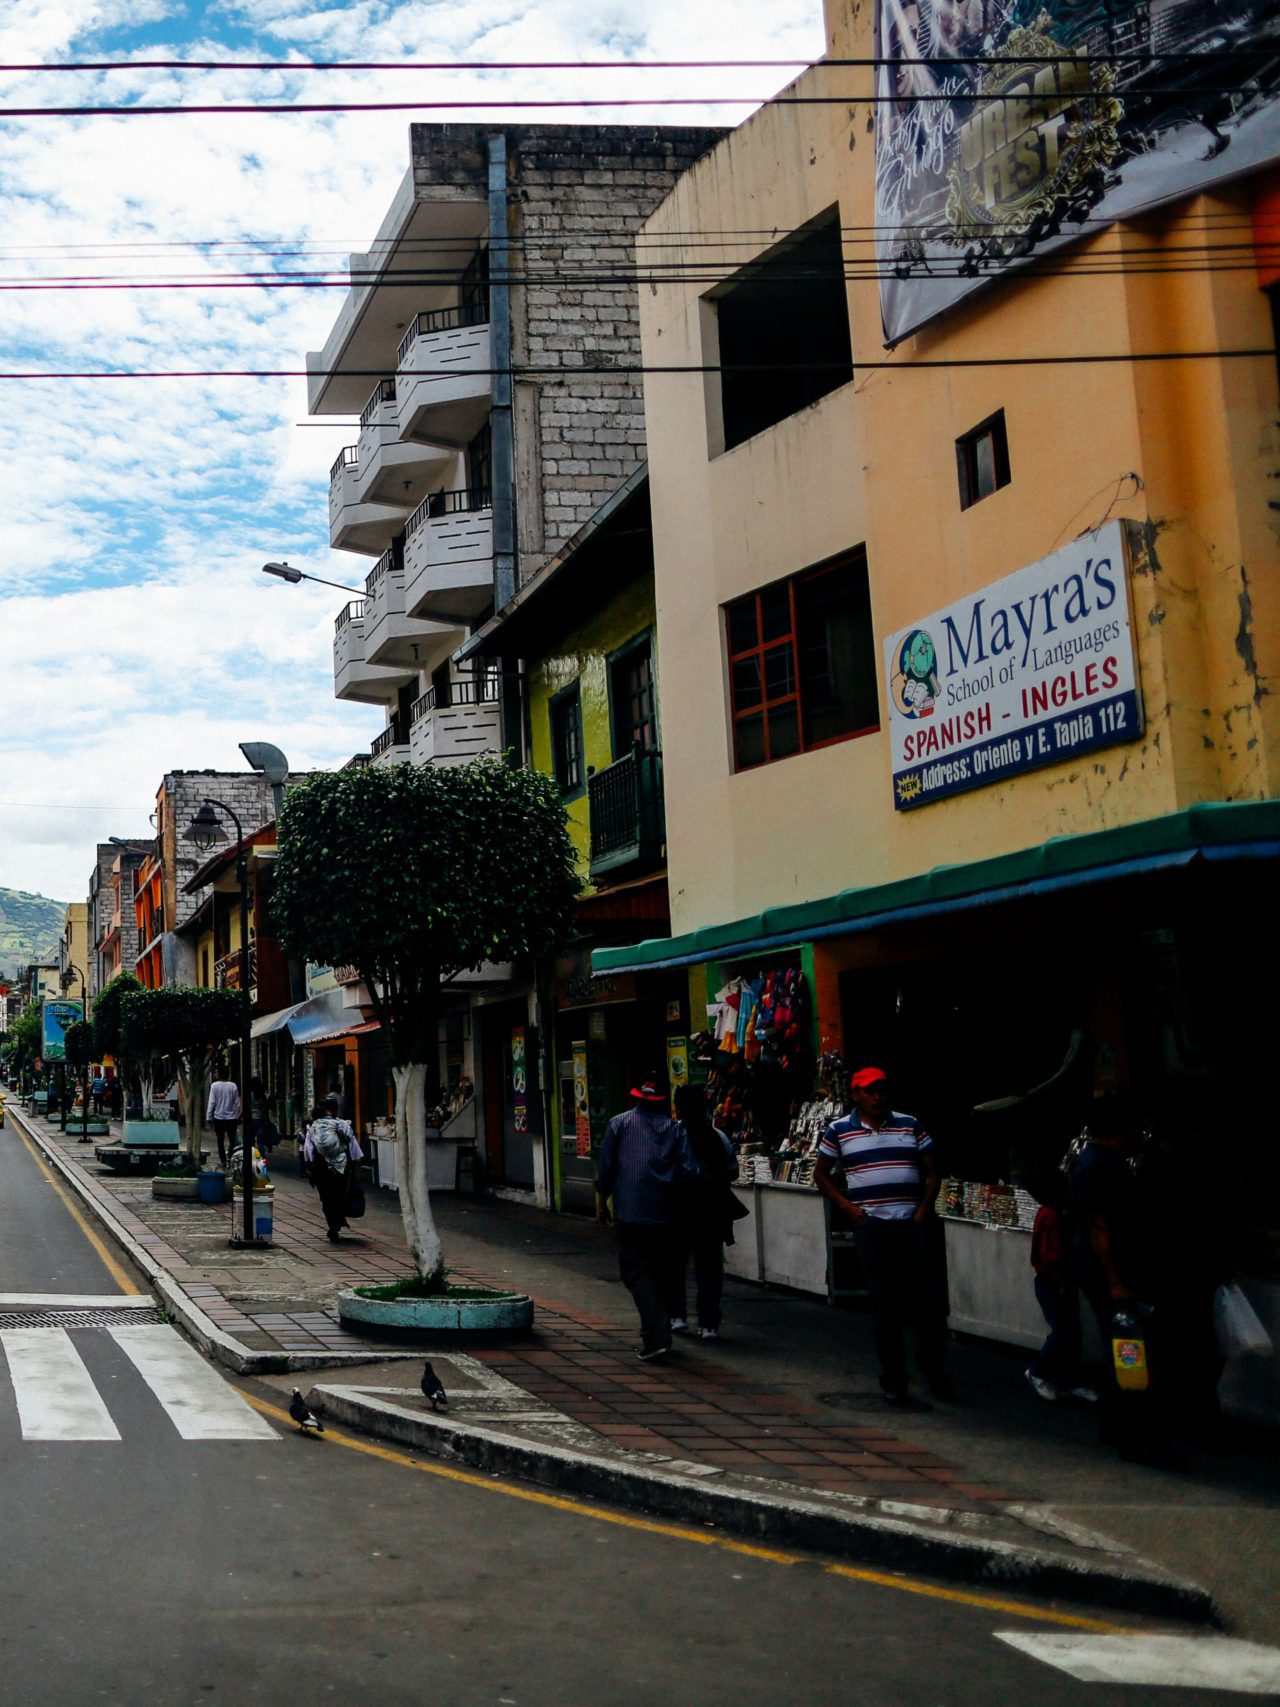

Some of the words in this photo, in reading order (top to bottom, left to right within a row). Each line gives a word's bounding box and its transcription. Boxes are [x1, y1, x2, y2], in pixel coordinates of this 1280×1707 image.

[961, 44, 1090, 171] URBAN
[984, 113, 1066, 210] FEST
[940, 558, 1116, 677] Mayra's
[947, 666, 995, 706] School
[999, 656, 1016, 684] of
[1032, 620, 1120, 672] Languages
[903, 702, 992, 762] SPANISH
[1021, 655, 1119, 718] INGLES
[922, 757, 971, 792] Address:
[973, 738, 1021, 775] Oriente
[1025, 735, 1034, 760] y
[1038, 727, 1051, 754] E.
[1054, 714, 1094, 751] Tapia
[1099, 701, 1127, 734] 112
[899, 778, 919, 793] NEW
